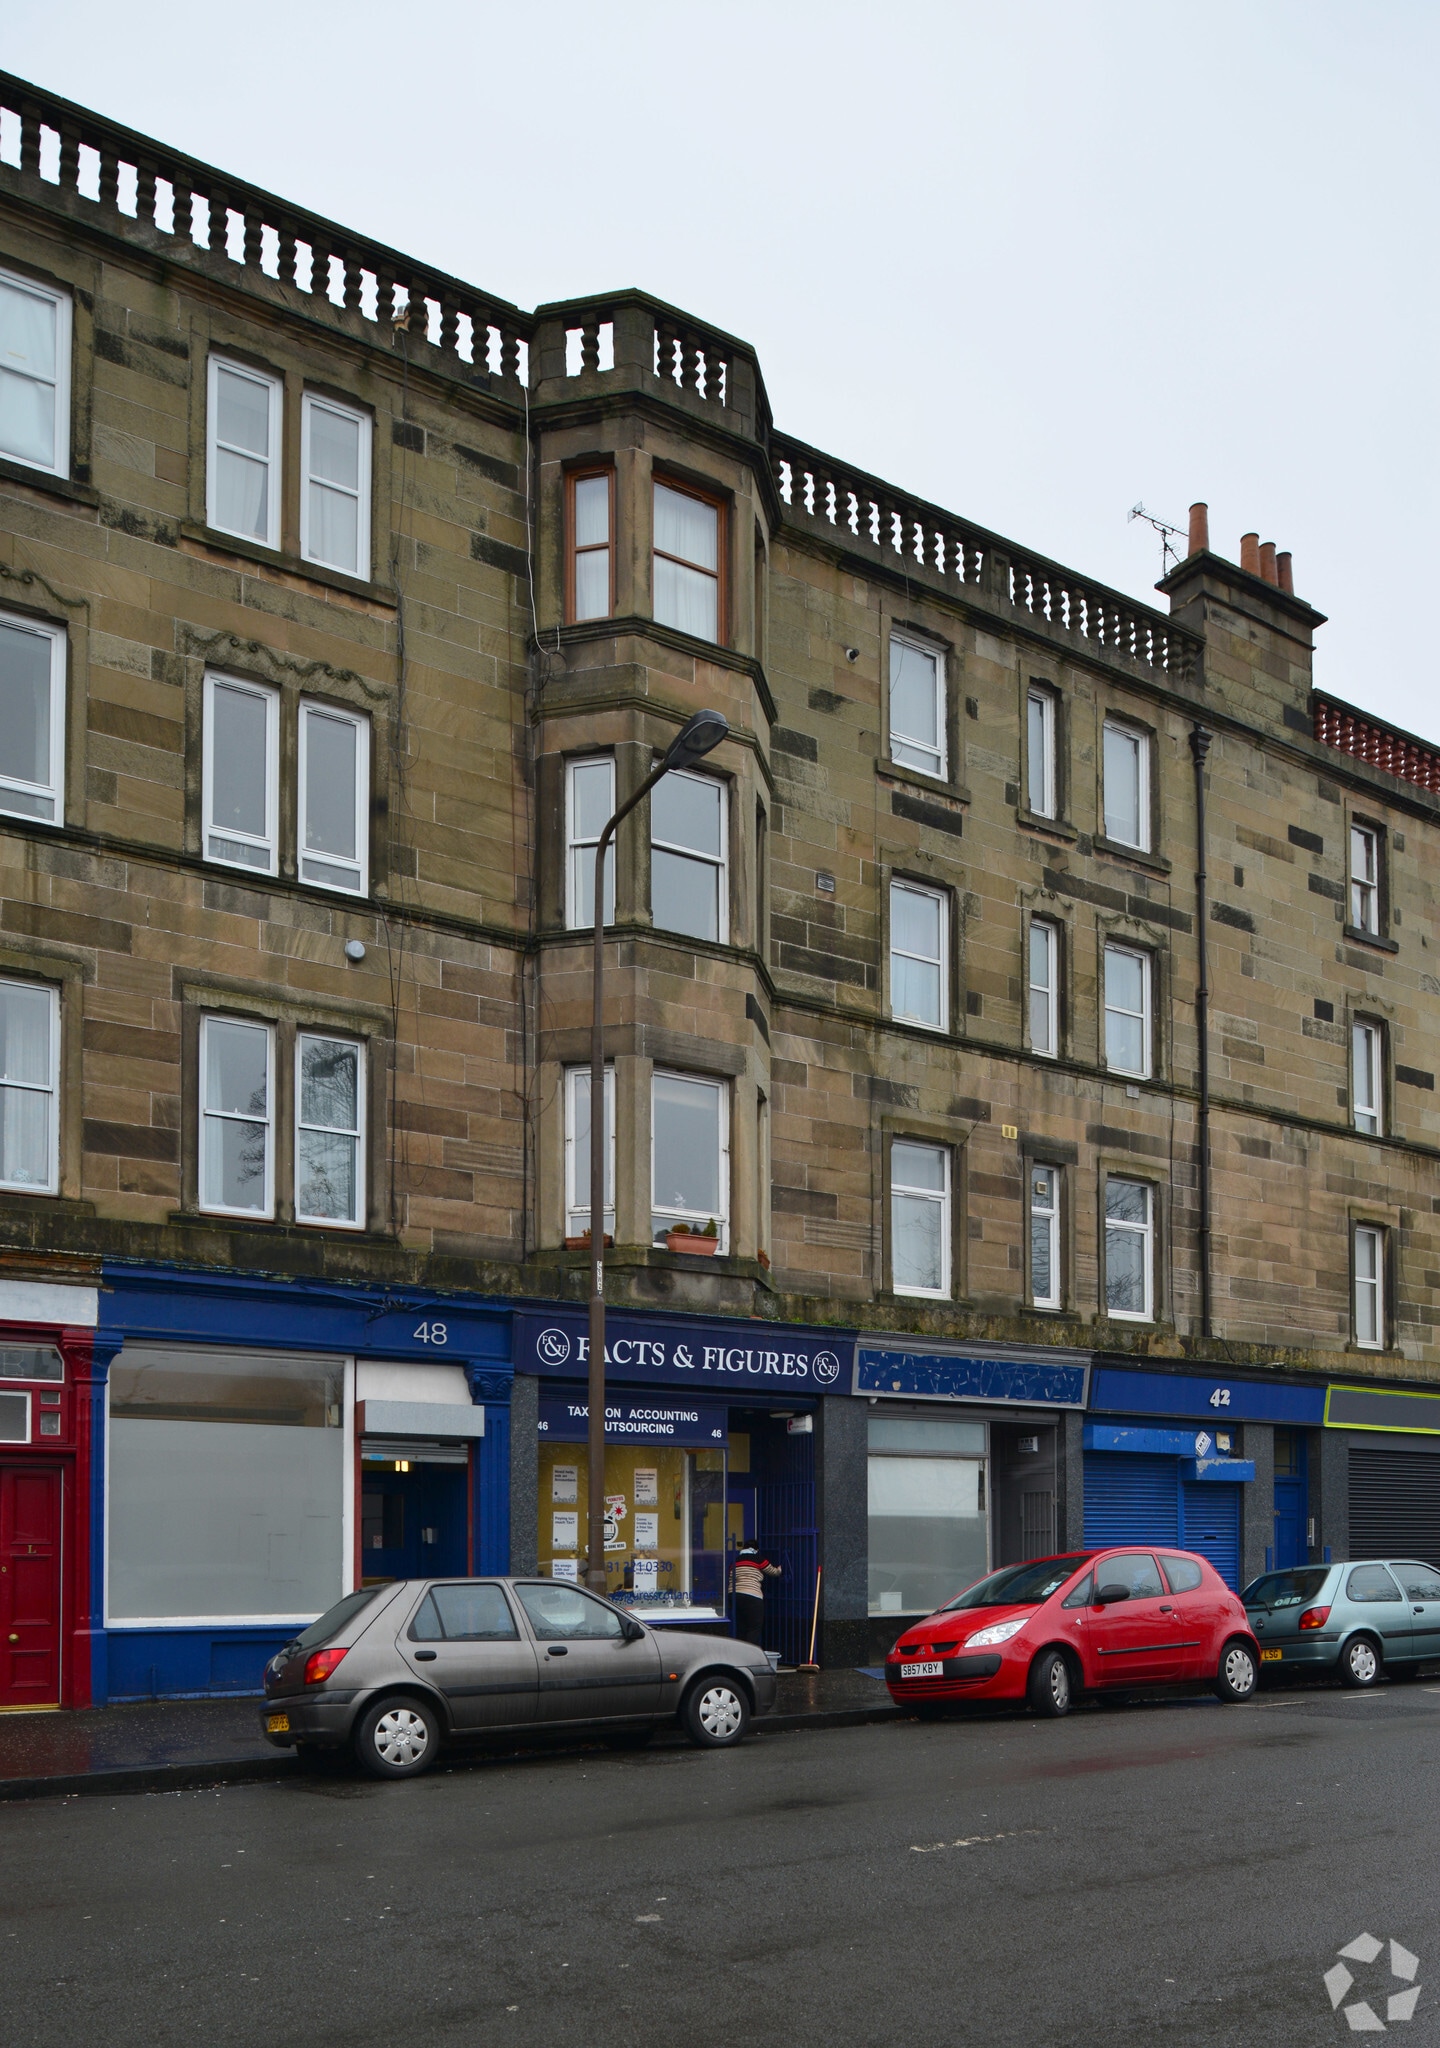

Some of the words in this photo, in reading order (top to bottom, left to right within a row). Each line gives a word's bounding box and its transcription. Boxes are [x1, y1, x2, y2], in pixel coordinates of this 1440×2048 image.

[413, 1321, 447, 1345] 48
[672, 1344, 695, 1368] &
[702, 1346, 808, 1377] FIGURES
[1210, 1388, 1230, 1407] 42
[629, 1408, 698, 1422] ACCOUNTING
[537, 1421, 548, 1430] 46
[604, 1421, 674, 1434] UTSOURCING
[711, 1428, 722, 1439] 46
[27, 1544, 37, 1554] L
[645, 1561, 673, 1573] 0330
[903, 1664, 920, 1676] SB57
[922, 1662, 938, 1674] KBY
